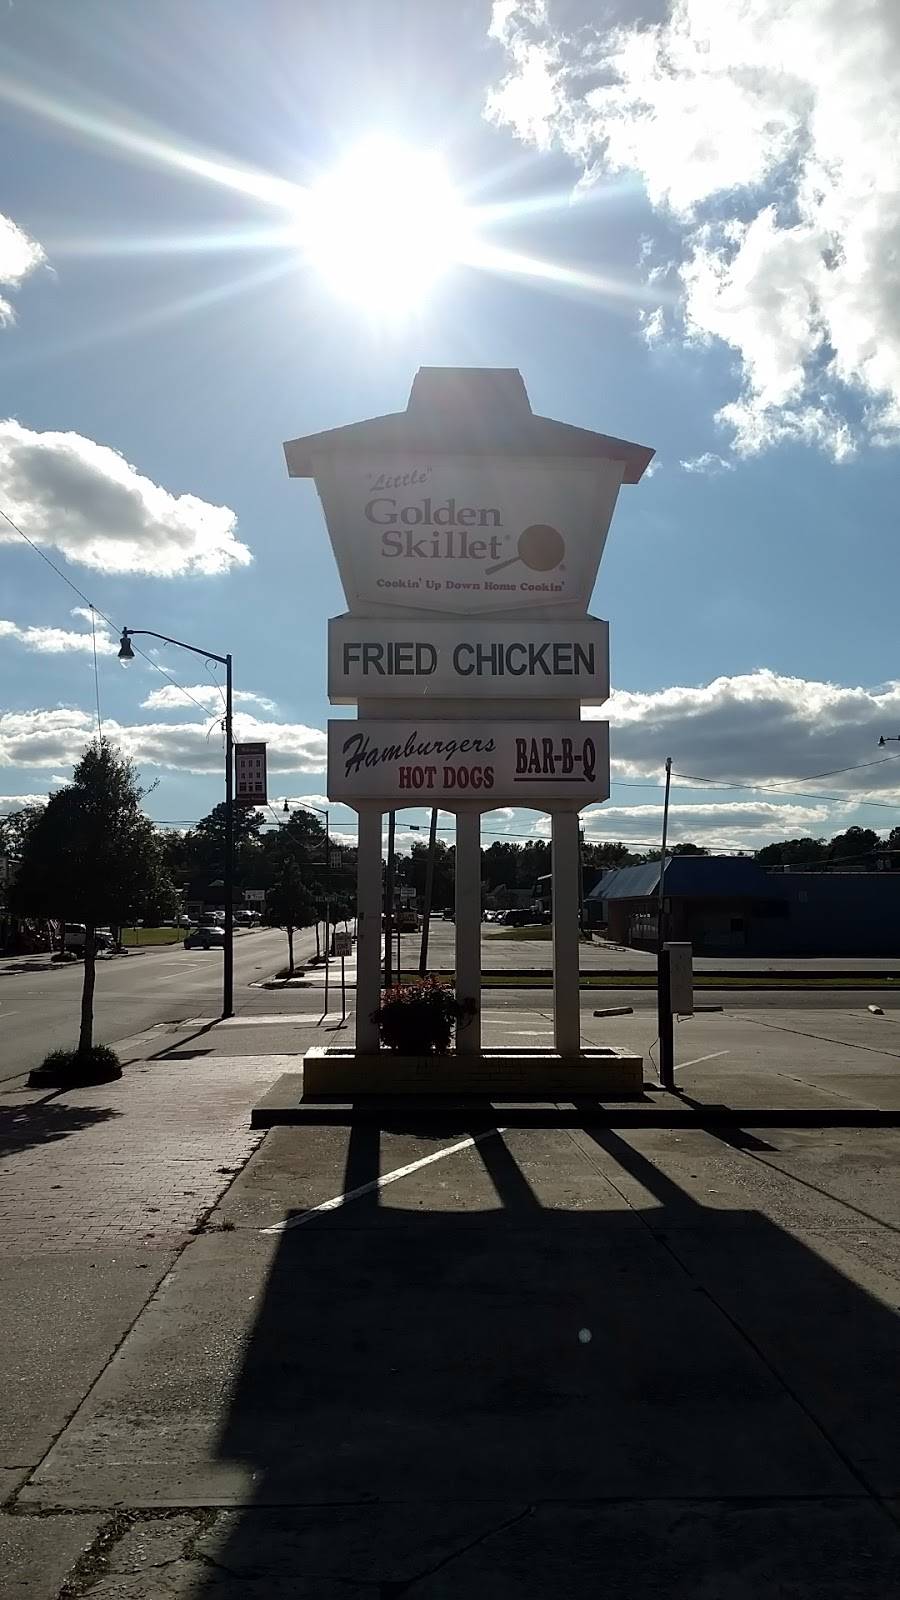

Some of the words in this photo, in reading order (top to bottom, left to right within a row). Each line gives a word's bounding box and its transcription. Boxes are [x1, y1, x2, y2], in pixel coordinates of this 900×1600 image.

[364, 498, 503, 527] Golden
[377, 577, 422, 589] Cookin'
[426, 580, 442, 591] Up
[446, 580, 480, 591] Down
[484, 581, 517, 591] Home
[520, 581, 565, 592] Cookin'
[343, 642, 437, 675] FRIED
[453, 643, 595, 676] CHICKEN
[342, 731, 496, 778] Hamburgers
[515, 737, 596, 783] BAR-B-Q
[398, 766, 437, 789] HOT
[443, 766, 495, 789] DOGS
